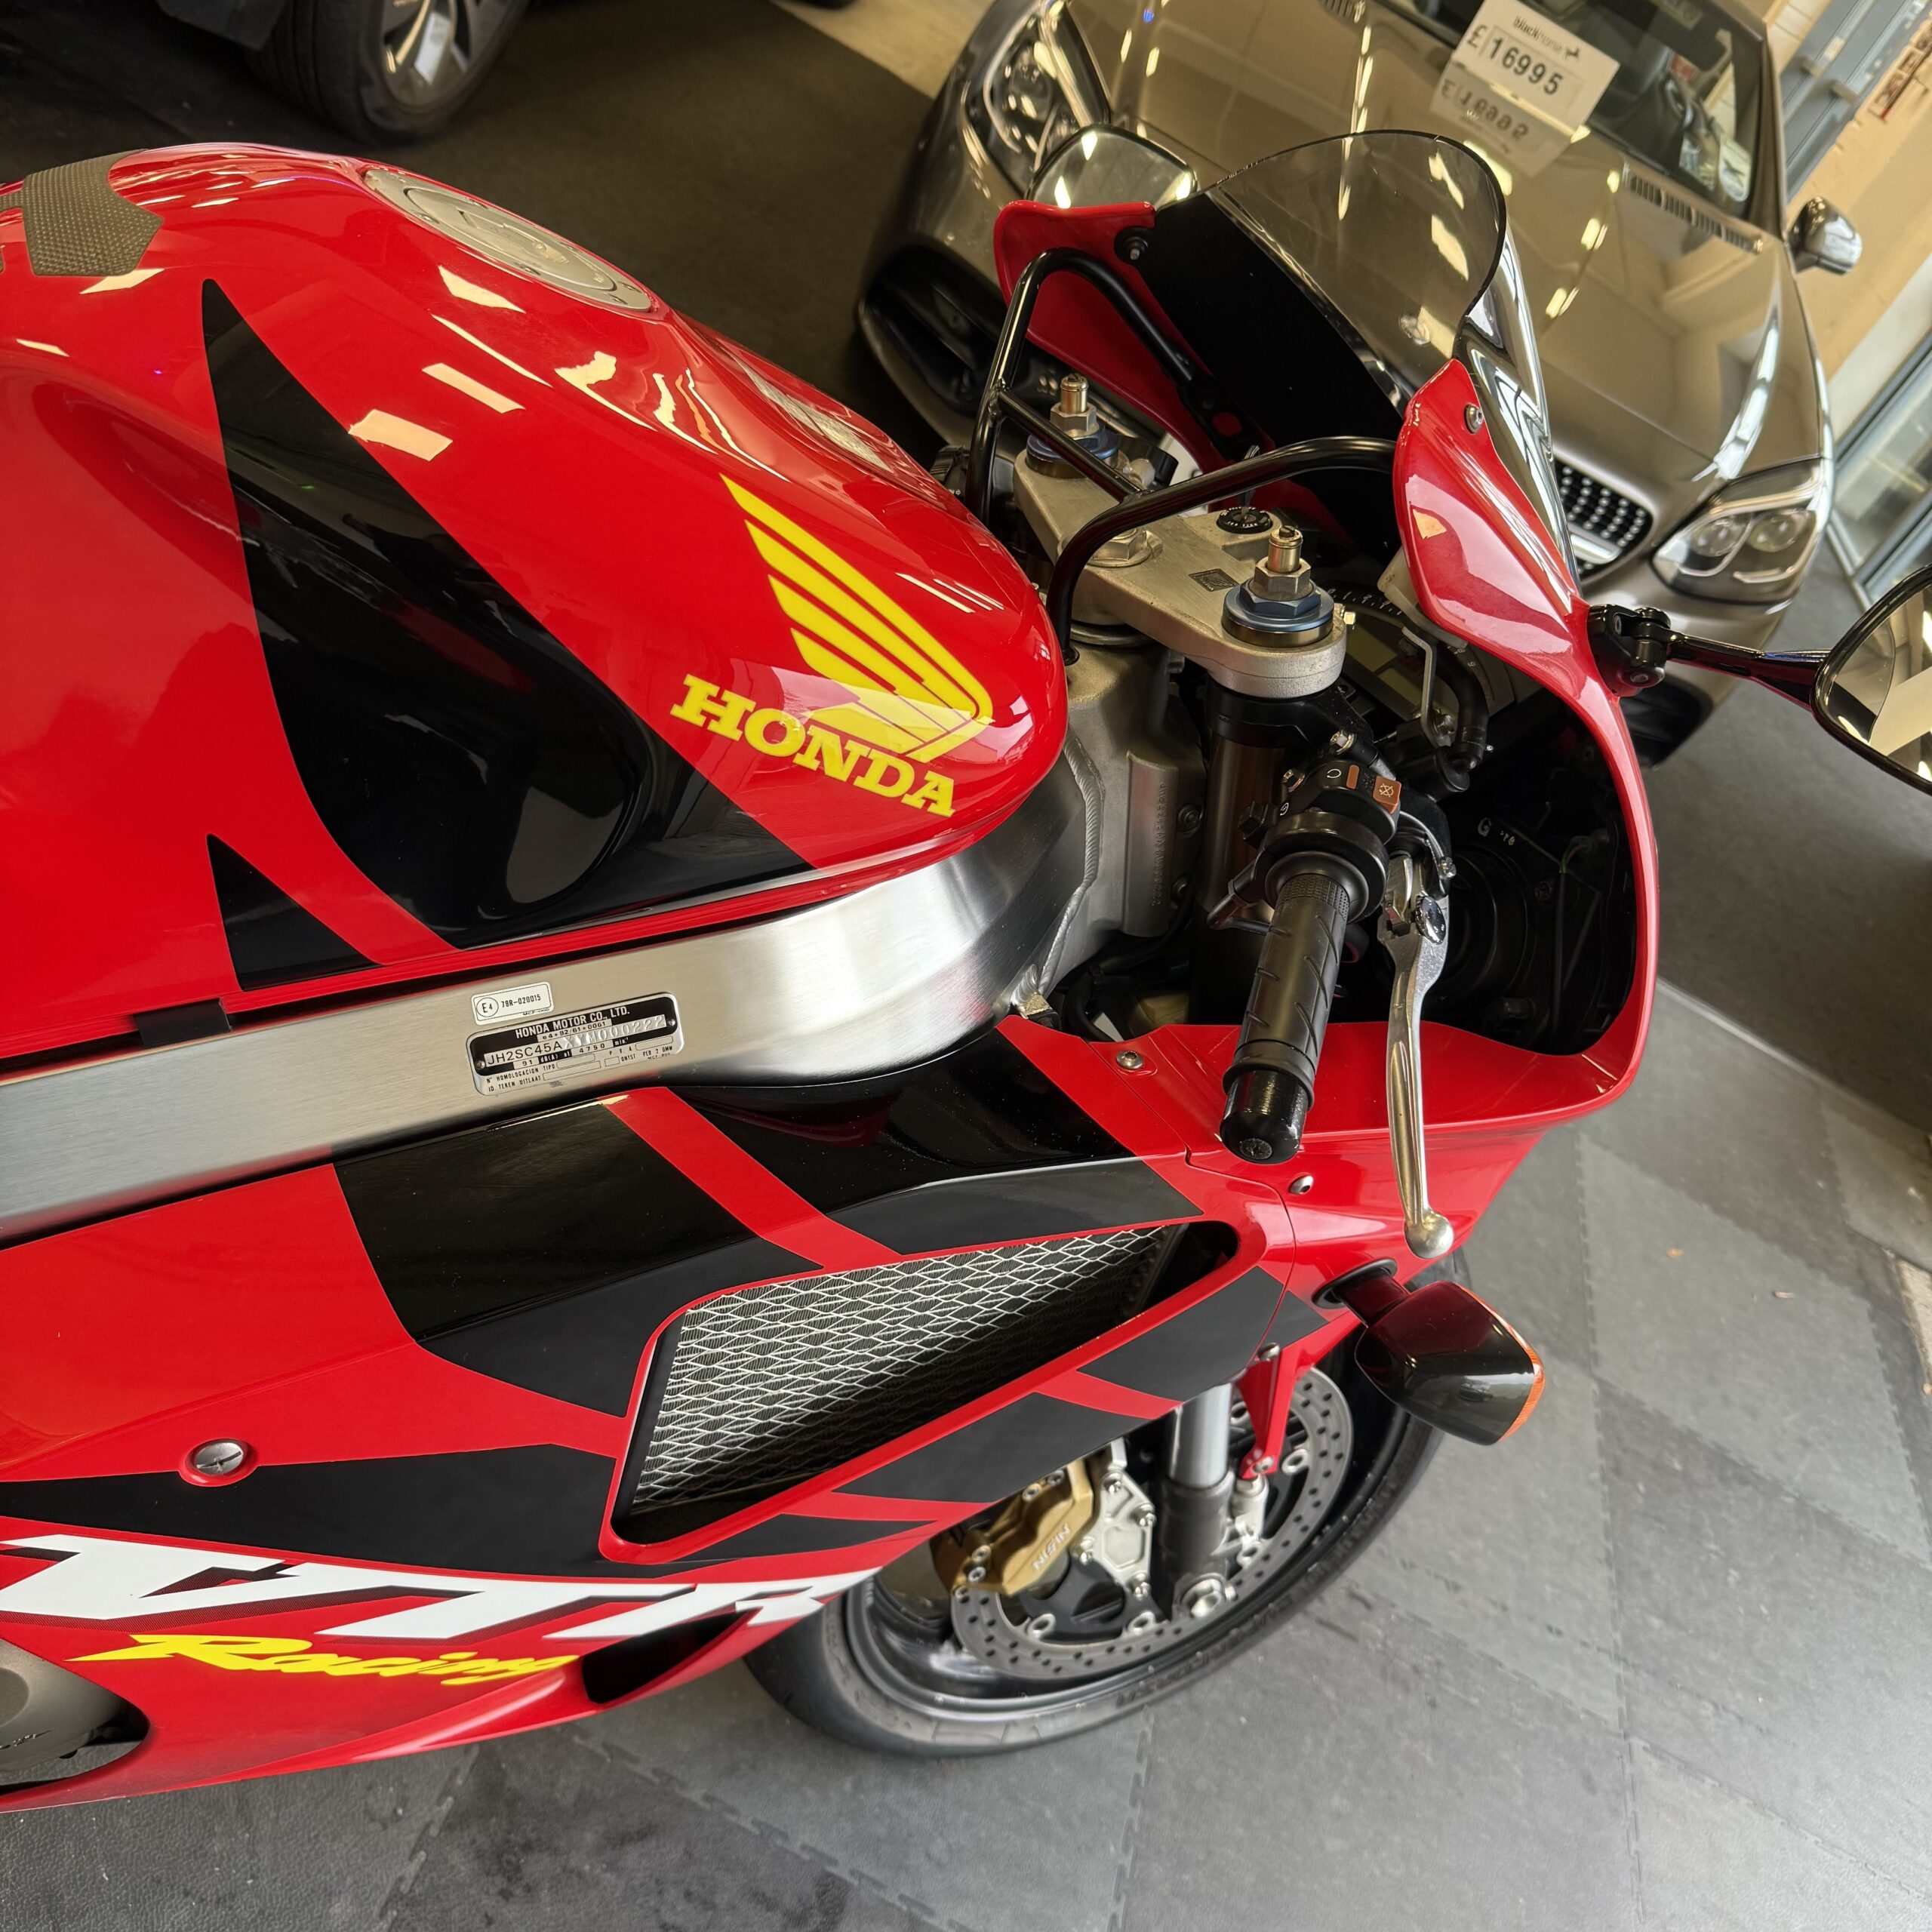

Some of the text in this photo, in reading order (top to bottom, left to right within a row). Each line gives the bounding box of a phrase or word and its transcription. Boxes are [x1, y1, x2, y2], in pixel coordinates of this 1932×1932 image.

[1467, 24, 1564, 95] £ 16995
[670, 674, 955, 817] HONDA
[500, 994, 541, 1008] 78R-020015
[515, 1024, 550, 1039] HONDA
[552, 1015, 587, 1031] MOTOR
[610, 1006, 630, 1018] LTD.
[497, 1068, 539, 1081] HOMOLOGACION
[0, 1534, 883, 1639] VTR
[63, 1634, 580, 1686] Racing
